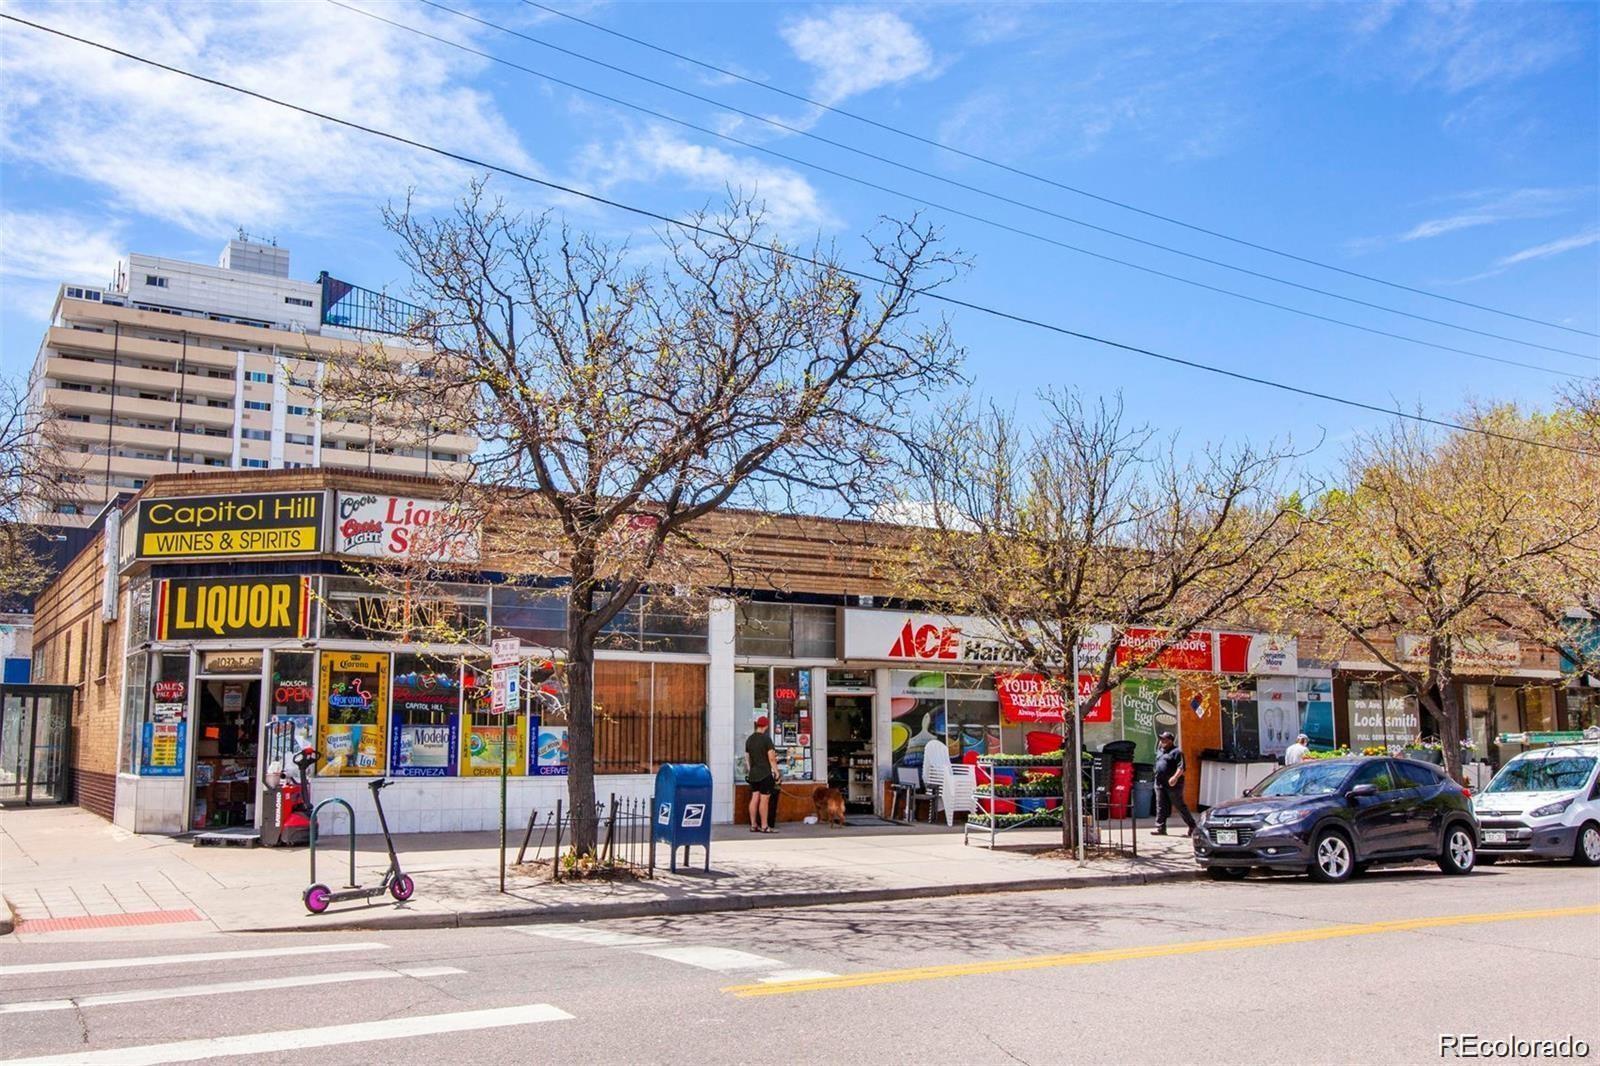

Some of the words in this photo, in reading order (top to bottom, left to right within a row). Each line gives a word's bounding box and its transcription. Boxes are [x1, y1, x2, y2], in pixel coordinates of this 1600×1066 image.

[149, 500, 264, 529] Capitol
[274, 496, 315, 520] Hill
[340, 495, 377, 520] Coors
[156, 533, 214, 552] WINES
[219, 532, 234, 550] &
[240, 530, 301, 551] SPIRITS
[344, 531, 382, 548] LIGHT
[177, 582, 291, 635] LIQUOR
[888, 617, 963, 659] ACE
[340, 660, 369, 671] Corona
[156, 682, 184, 692] DALE'S
[775, 687, 796, 700] OPEN
[1003, 680, 1039, 693] YOUR
[1138, 686, 1154, 704] Big
[275, 687, 314, 704] OPEN
[1123, 695, 1153, 712] Green
[405, 702, 430, 711] CAPITOL
[432, 704, 445, 712] HILL
[1134, 710, 1153, 727] Egg
[1354, 713, 1417, 728] Locksmith
[415, 728, 449, 746] Modelo
[403, 768, 446, 777] CERVEZA
[472, 769, 513, 777] CERVEA
